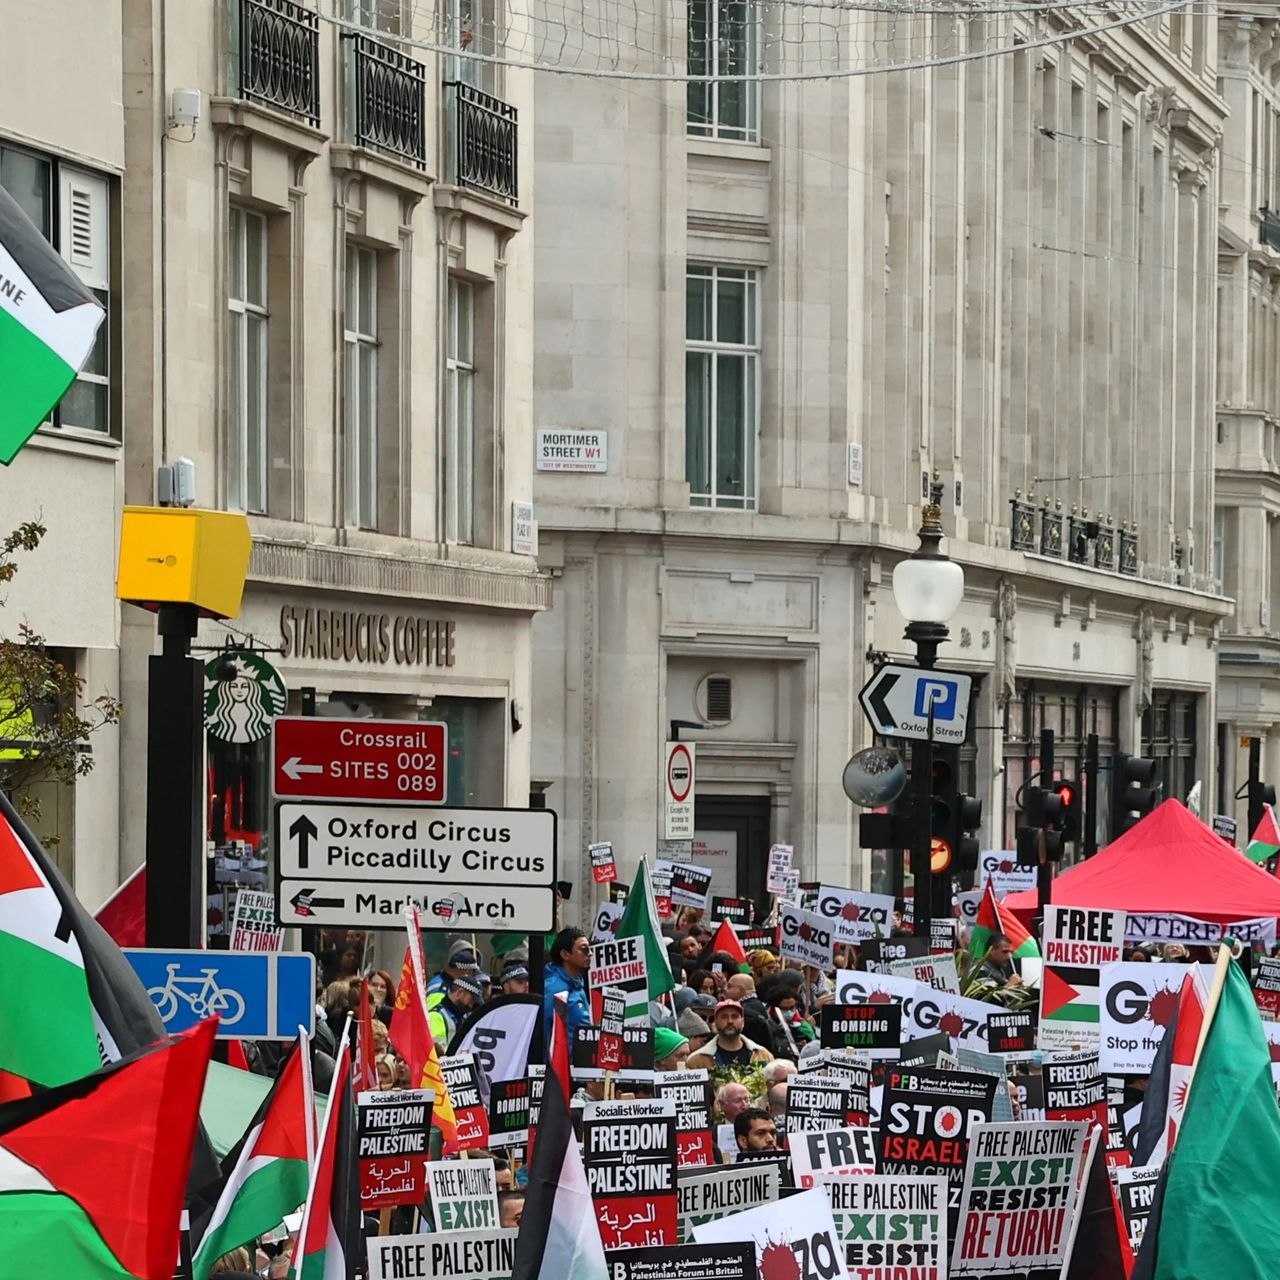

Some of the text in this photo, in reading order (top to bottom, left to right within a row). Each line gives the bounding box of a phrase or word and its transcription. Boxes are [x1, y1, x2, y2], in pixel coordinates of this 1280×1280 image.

[543, 434, 599, 446] MORTIMER
[543, 447, 601, 458] STREET W1
[280, 605, 456, 667] STARBUCKS COFFEE
[922, 682, 949, 714] P
[901, 722, 964, 737] Oxfor Street
[340, 729, 427, 749] Crossrail
[330, 760, 389, 780] SITES
[397, 752, 436, 771] 002
[397, 774, 436, 792] 089
[327, 818, 511, 843] Oxford Circus
[327, 846, 545, 873] Piccadilly Circus
[356, 894, 515, 918] Marle Arch
[843, 1006, 876, 1020] STOP
[990, 1016, 1030, 1028] SANCTIONS
[832, 1019, 889, 1035] BOMBING
[1006, 1027, 1018, 1038] ON
[844, 1032, 875, 1046] GAZA
[370, 1092, 424, 1103] Socialist Worker
[365, 1106, 425, 1128] FREEDOM
[390, 1126, 400, 1136] for
[360, 1133, 425, 1156] PALESTINE
[368, 1160, 411, 1181] الحرية
[360, 1176, 416, 1199] لفلسطين
[631, 1270, 676, 1280] Palestinian
[677, 1269, 705, 1279] Forum
[716, 1266, 743, 1276] Britain
